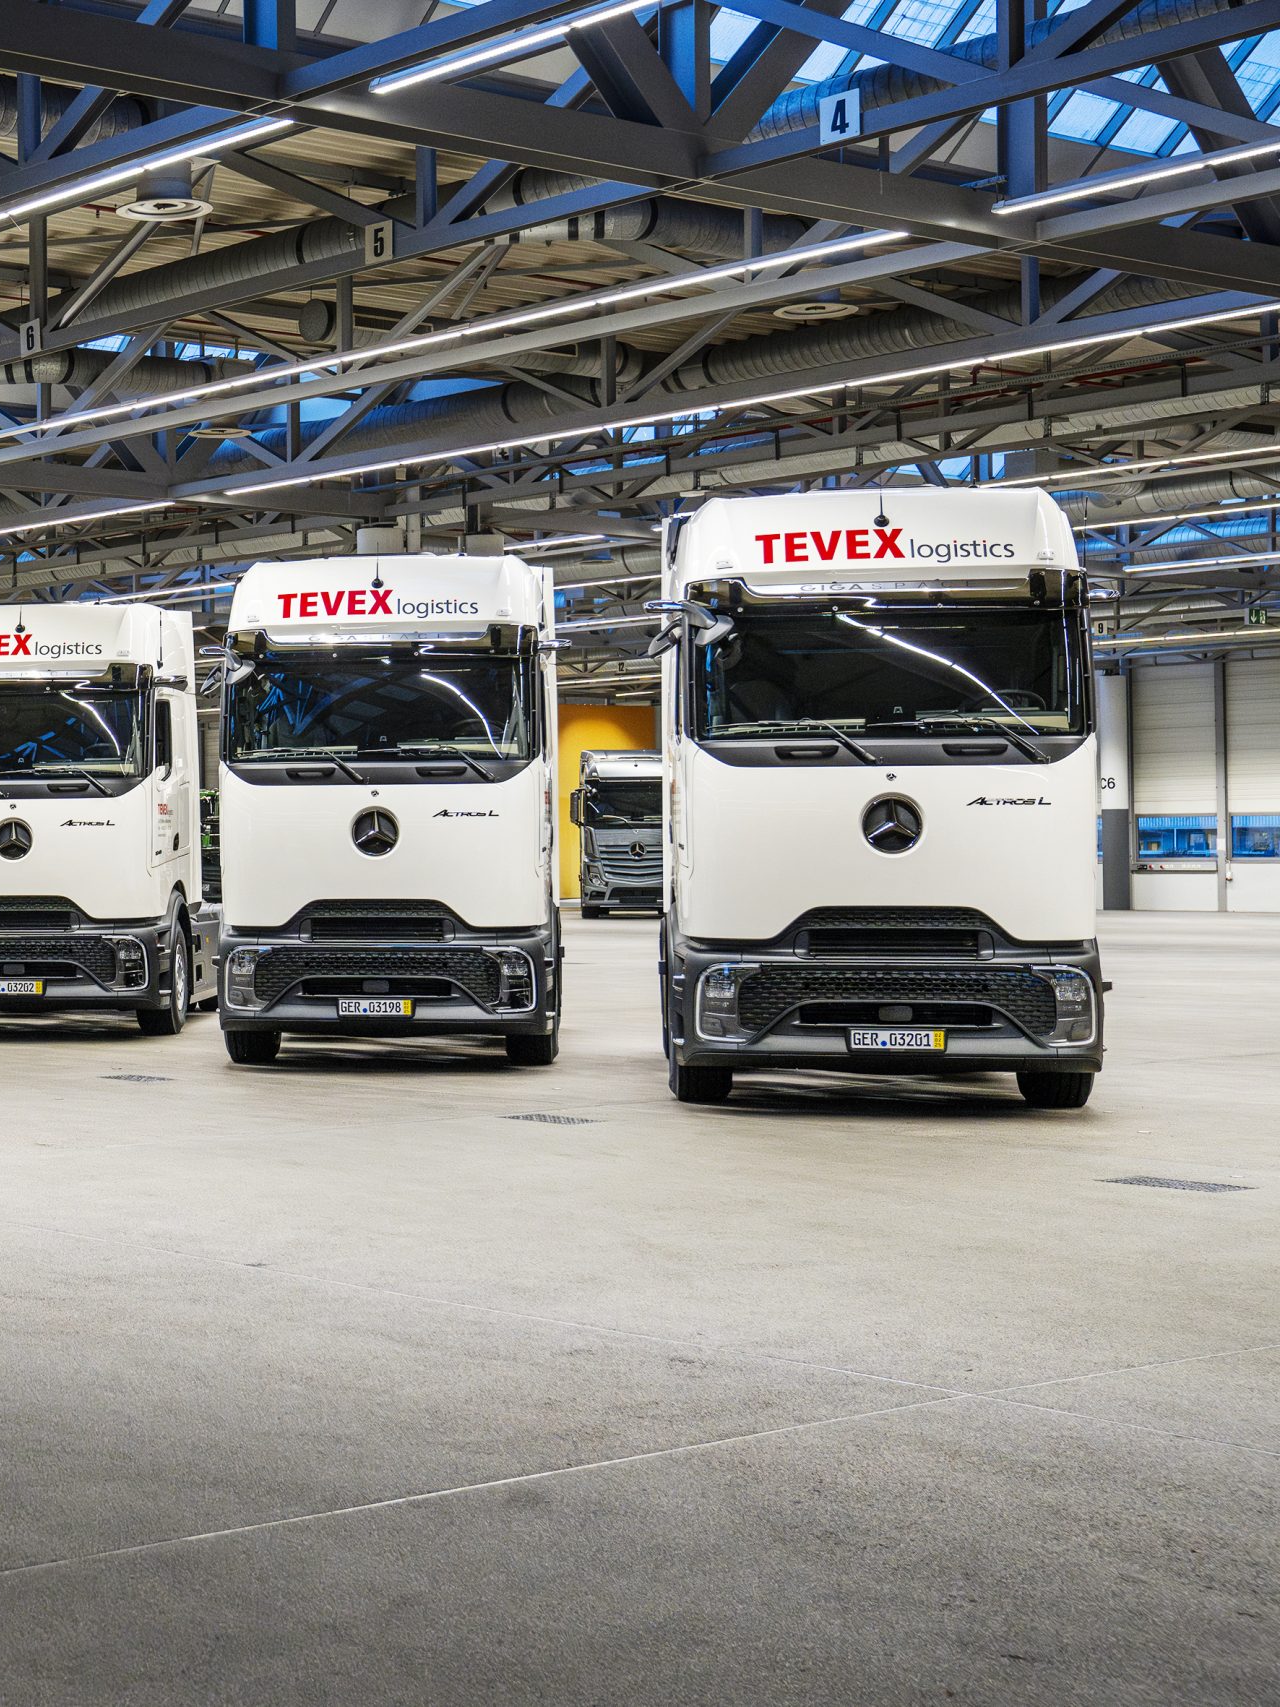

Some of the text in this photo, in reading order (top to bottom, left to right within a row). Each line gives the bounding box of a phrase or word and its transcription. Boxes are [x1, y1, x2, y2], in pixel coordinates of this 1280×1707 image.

[831, 98, 849, 134] 4
[374, 227, 384, 257] 5
[26, 325, 34, 351] 6
[755, 528, 1014, 564] TEVEX logistics
[278, 589, 479, 618] TEVEX logistics
[34, 641, 102, 659] logistics
[432, 809, 487, 817] ACTROS
[966, 797, 1052, 806] ACTROS L
[60, 819, 105, 827] ACTROS
